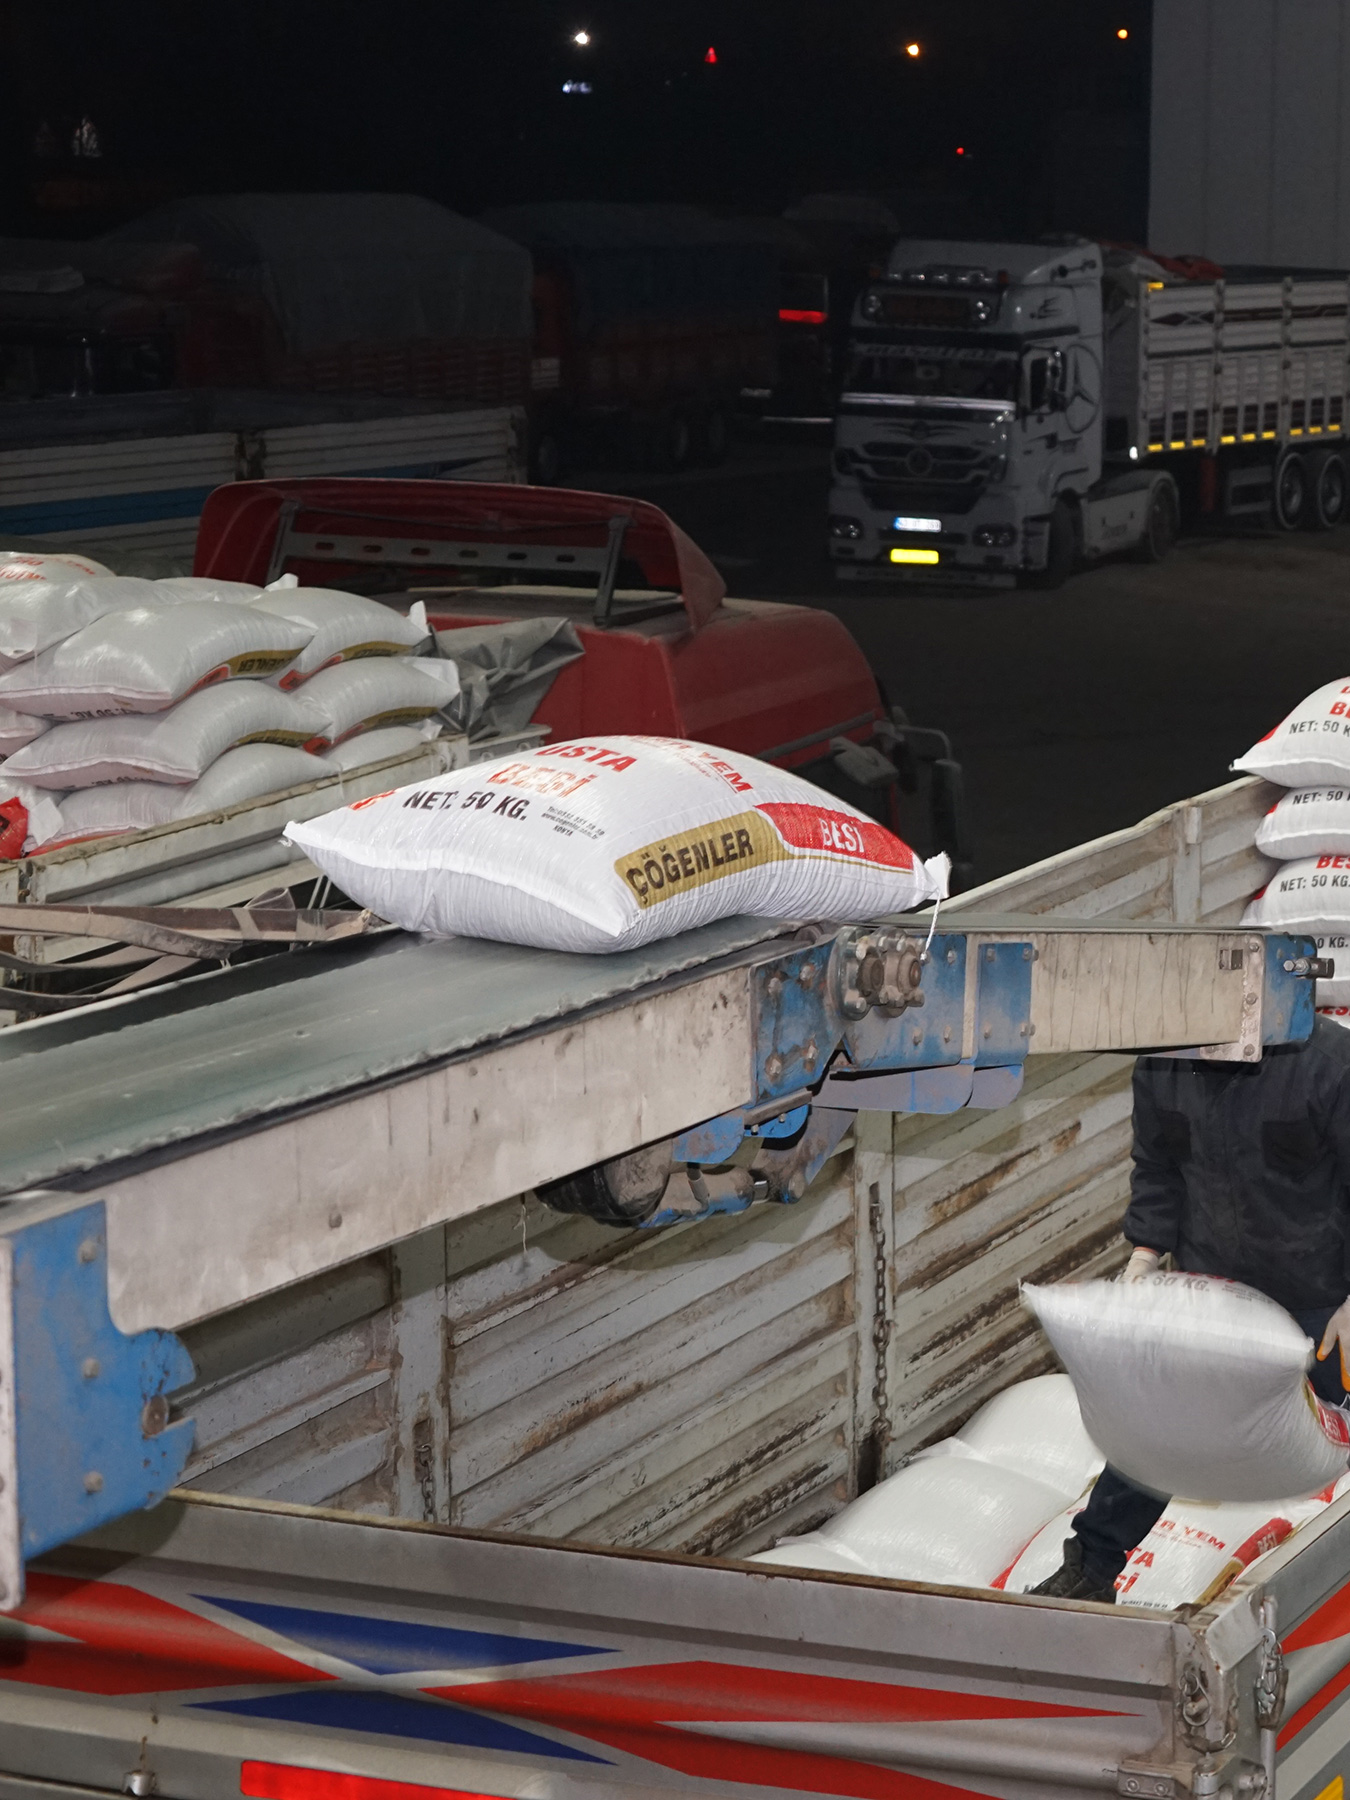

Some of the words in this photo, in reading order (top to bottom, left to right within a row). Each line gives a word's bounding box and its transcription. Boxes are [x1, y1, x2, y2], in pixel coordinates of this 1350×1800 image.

[1289, 720, 1318, 735] NET:
[1322, 720, 1340, 734] 50
[535, 745, 638, 773] USTA
[699, 752, 753, 792] YEM
[461, 791, 495, 810] 50
[492, 796, 530, 821] KG.
[1293, 792, 1322, 805] NET:
[1327, 790, 1343, 801] 50
[820, 818, 865, 853] BESİ
[626, 828, 754, 905] ÇÖĞENLER
[1280, 877, 1307, 892] NET:
[1311, 875, 1328, 887] 50
[1329, 936, 1349, 949] KG.
[1184, 1526, 1226, 1551] YEM
